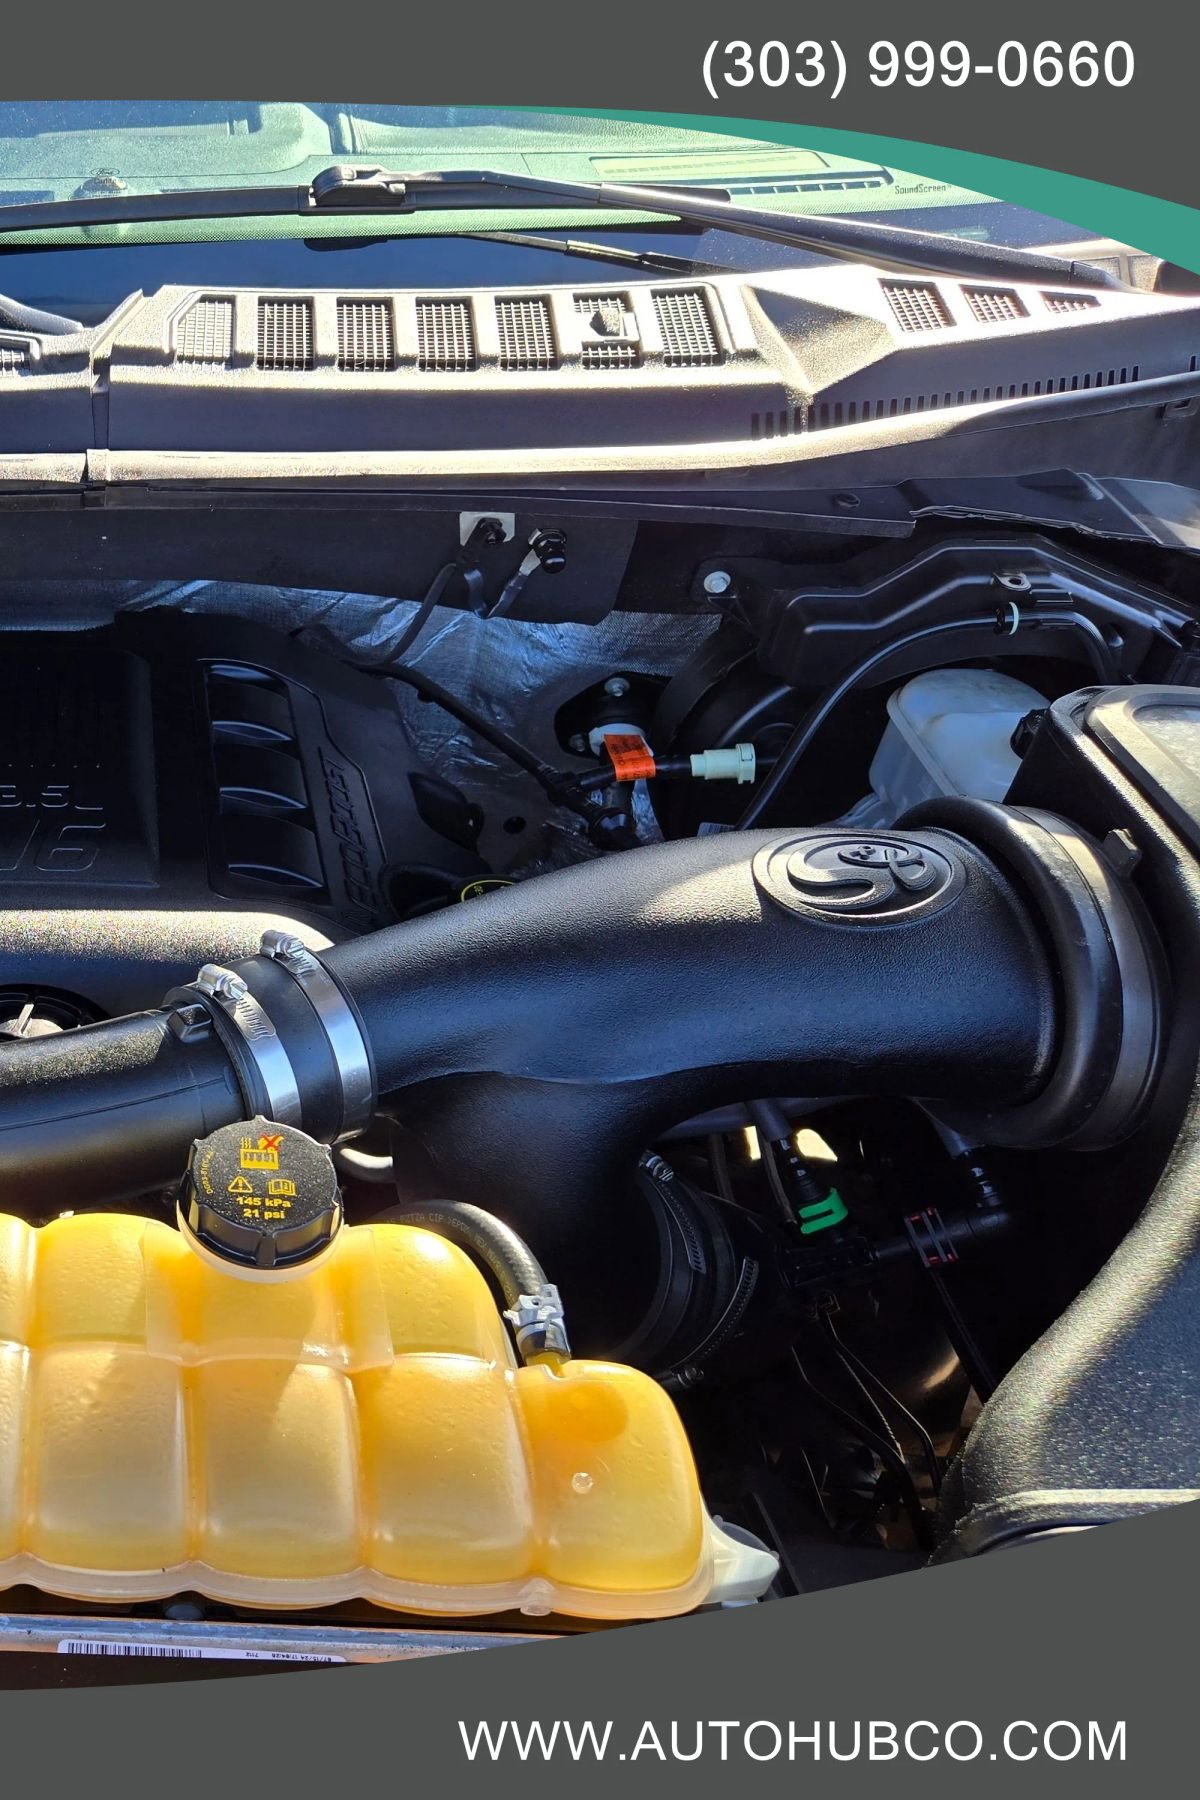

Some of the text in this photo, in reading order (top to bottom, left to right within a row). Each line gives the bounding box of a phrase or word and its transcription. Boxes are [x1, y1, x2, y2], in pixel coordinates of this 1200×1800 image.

[236, 1197, 291, 1208] 145 kPa
[243, 1208, 286, 1220] 21 psi
